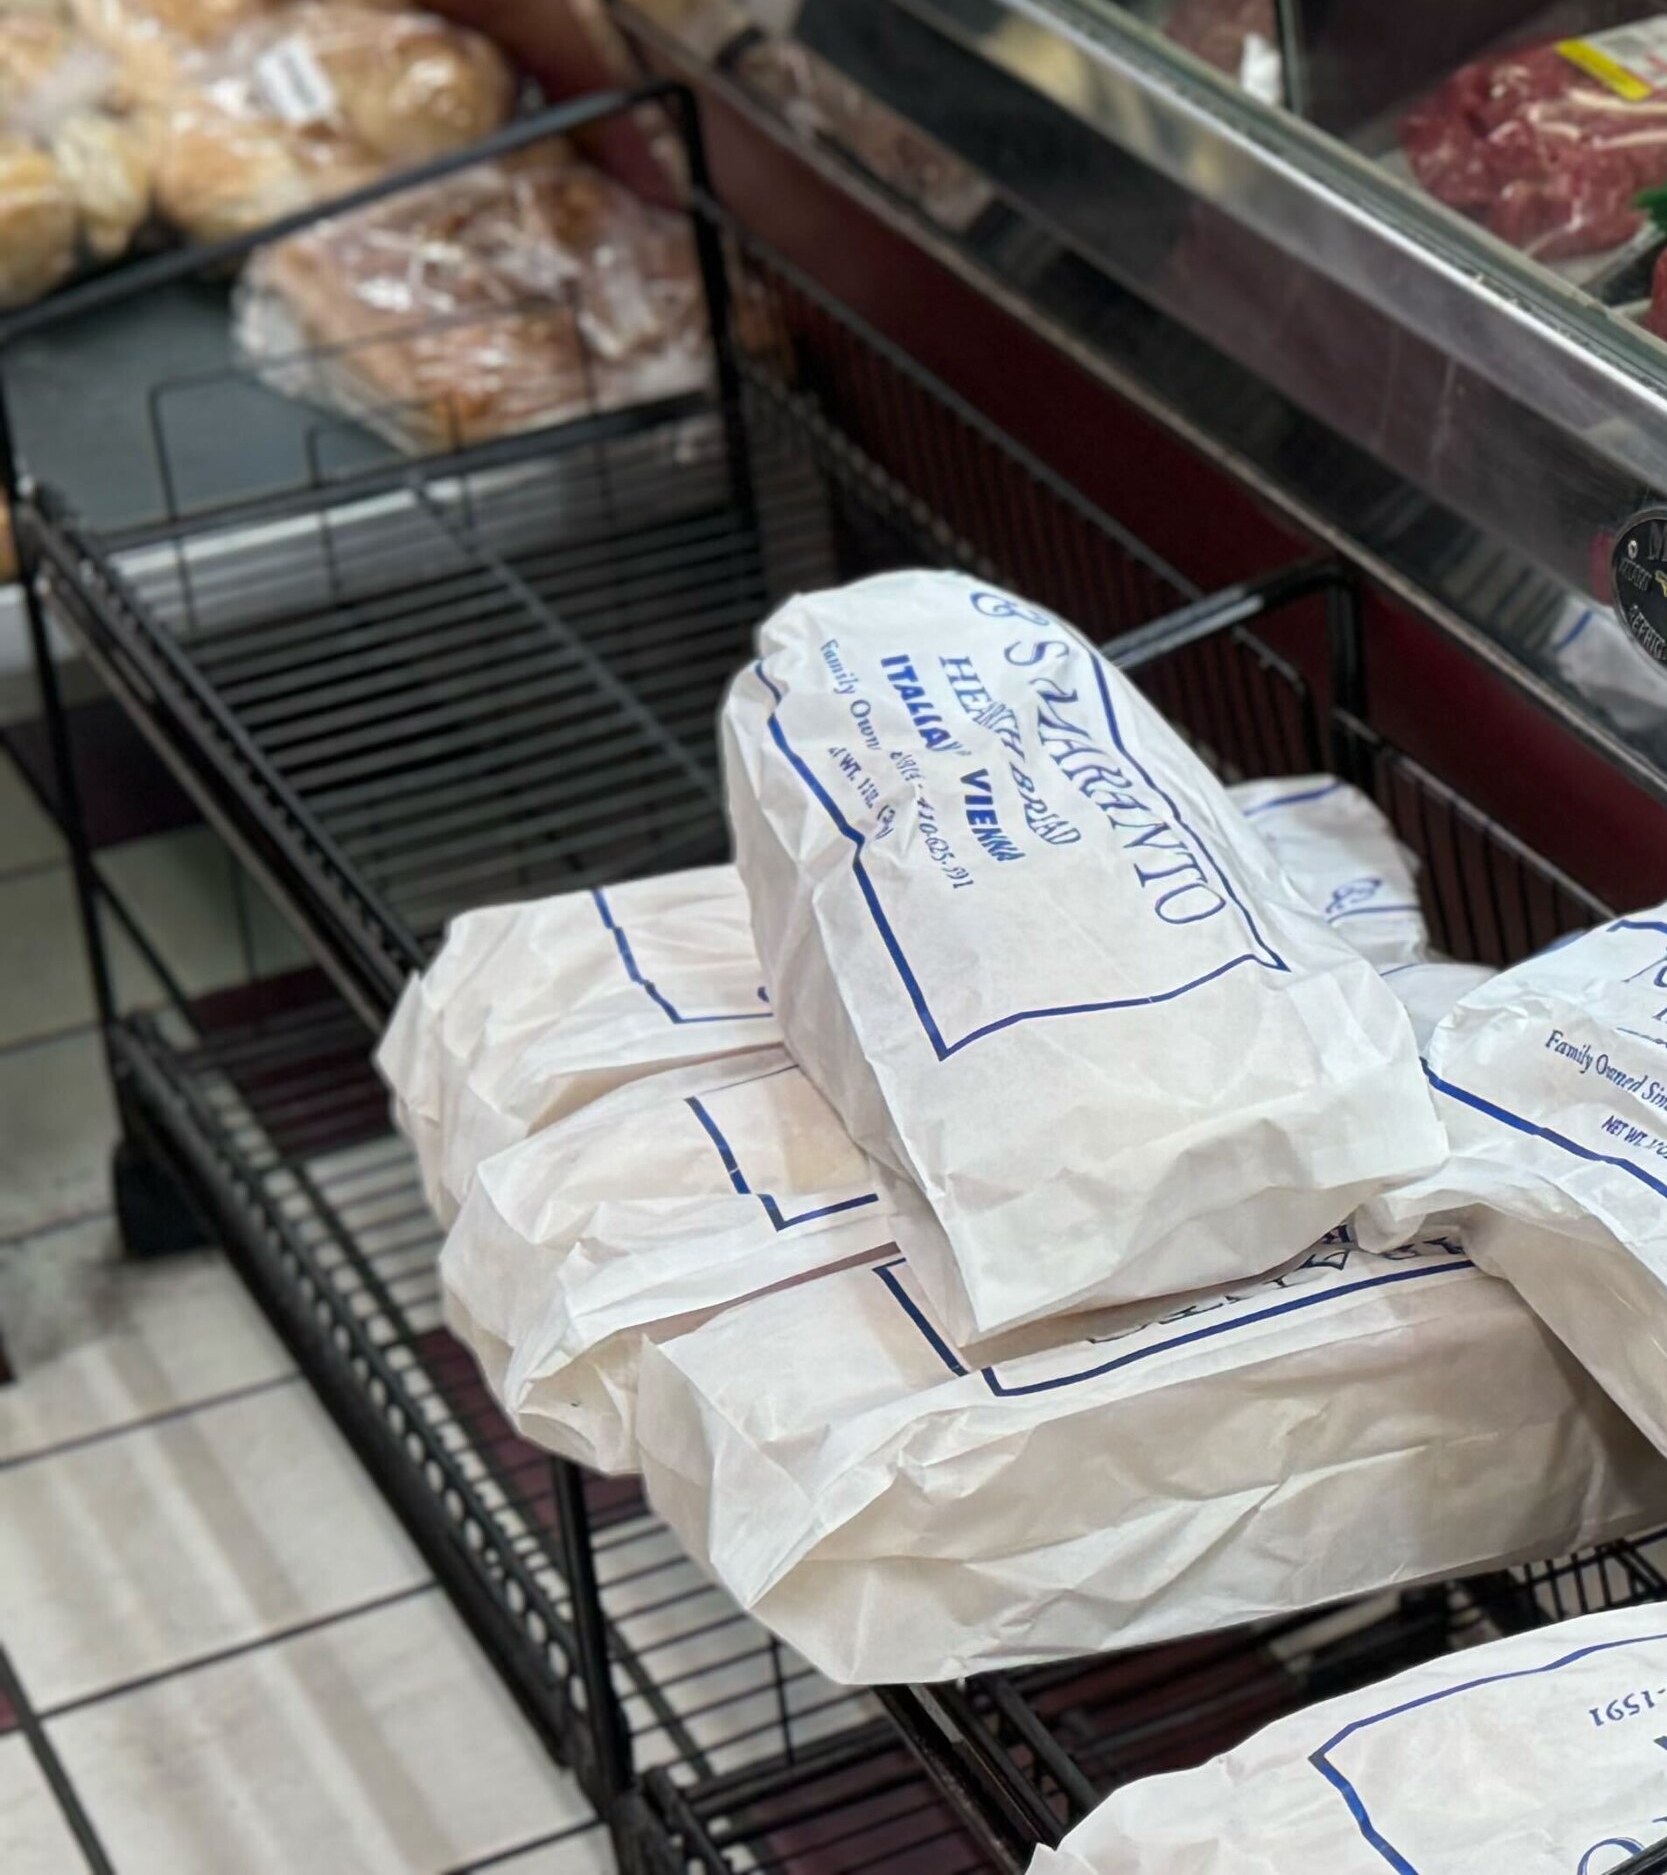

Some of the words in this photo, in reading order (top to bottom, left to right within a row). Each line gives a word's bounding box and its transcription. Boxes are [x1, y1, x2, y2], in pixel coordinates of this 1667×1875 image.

[820, 638, 856, 695] Family
[960, 768, 1027, 862] VIENNA
[1545, 1028, 1594, 1075] Family
[1595, 1053, 1649, 1094] Owned
[1601, 1115, 1630, 1137] NET
